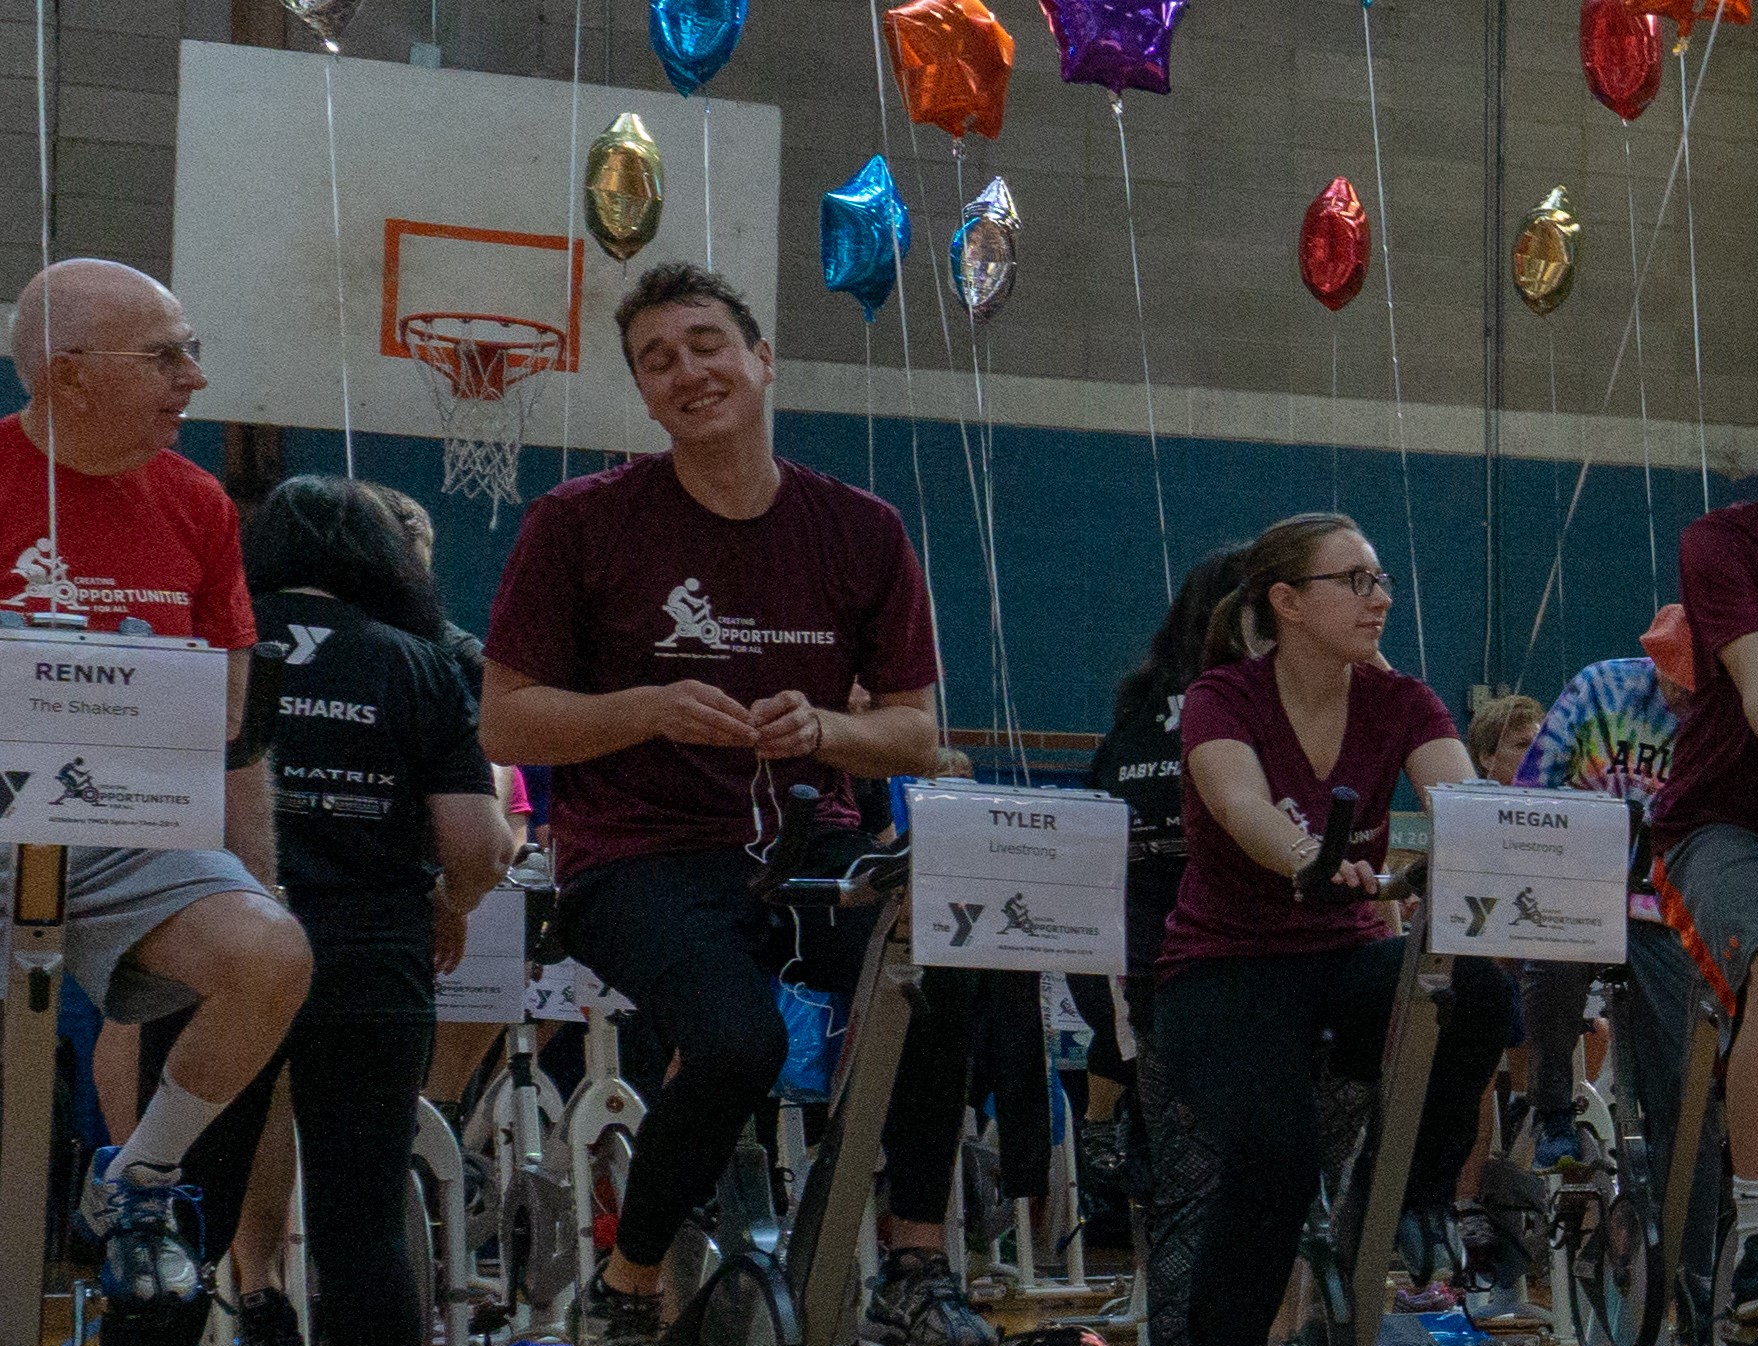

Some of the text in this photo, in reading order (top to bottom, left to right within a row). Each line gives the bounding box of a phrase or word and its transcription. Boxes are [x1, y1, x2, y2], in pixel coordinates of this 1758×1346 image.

[35, 662, 136, 685] RENNY
[29, 698, 140, 717] The Shakers
[279, 696, 378, 724] SHARKS
[283, 766, 396, 786] MATRIX
[1118, 761, 1157, 782] BABY
[988, 809, 1057, 831] TYLER
[1498, 809, 1569, 829] MEGAN
[989, 840, 1057, 859] Livestrong
[1502, 839, 1564, 856] Livestrong
